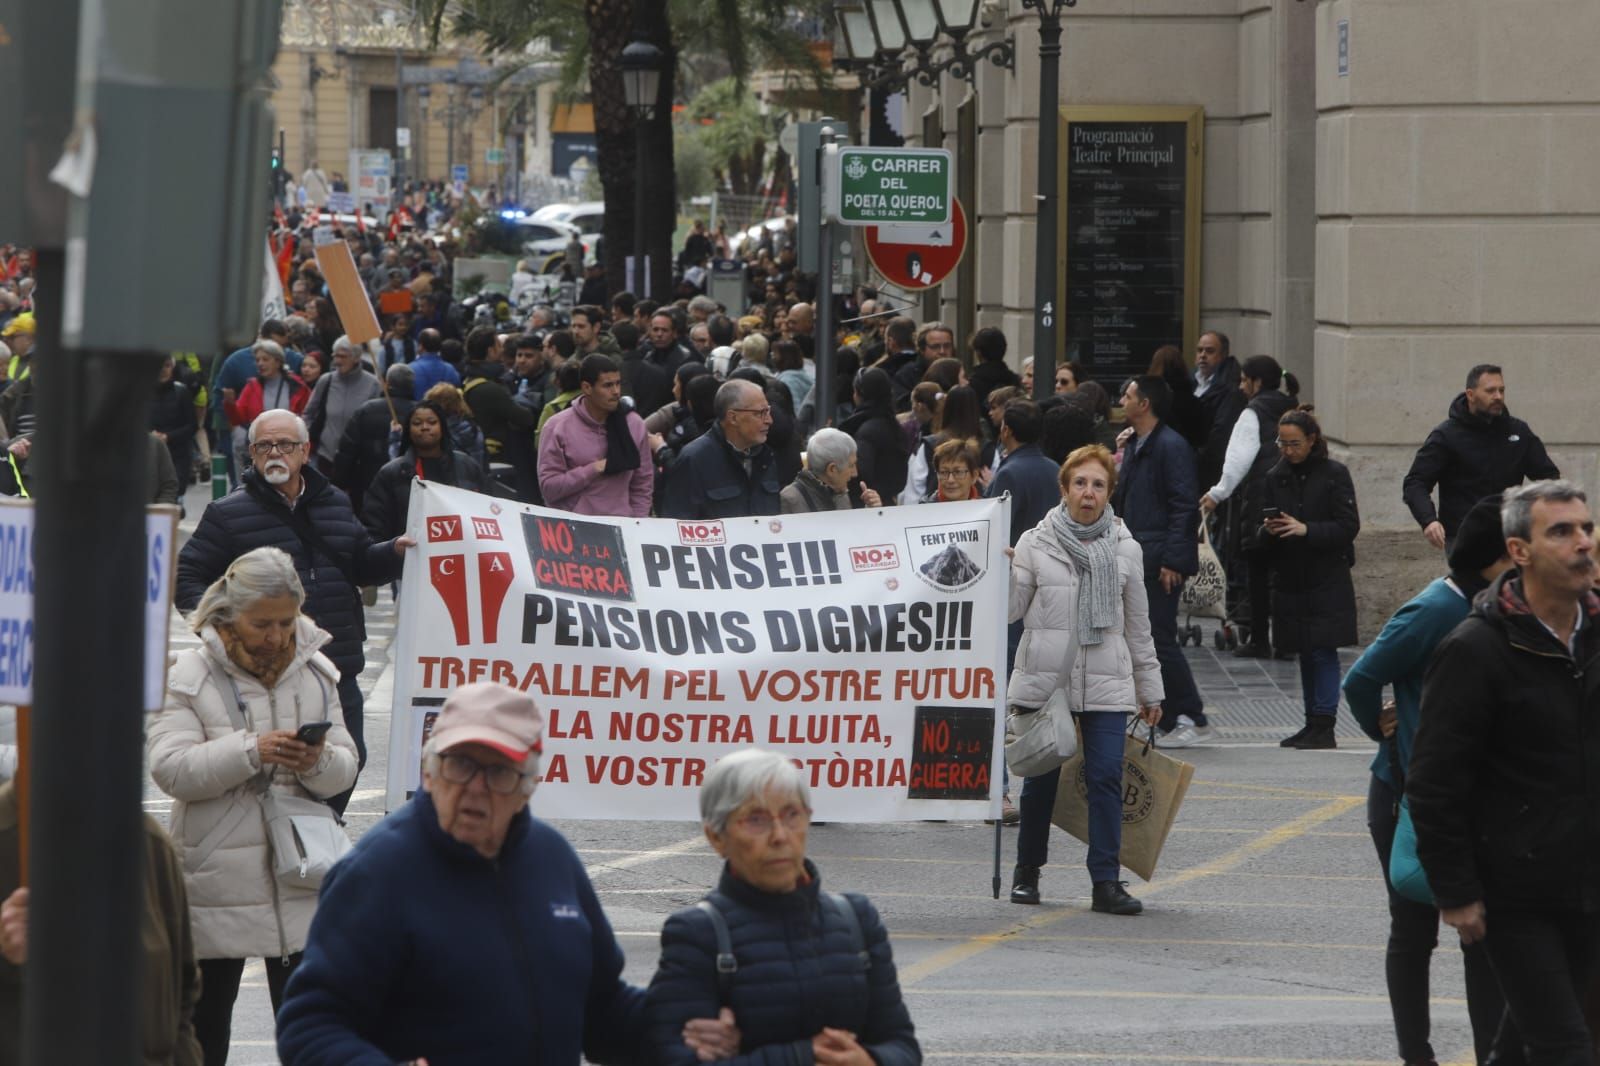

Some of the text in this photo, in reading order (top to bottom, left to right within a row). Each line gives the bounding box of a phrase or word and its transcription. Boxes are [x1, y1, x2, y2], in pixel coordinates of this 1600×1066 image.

[1074, 127, 1154, 148] Programació
[871, 158, 941, 173] CARRER
[1072, 144, 1174, 168] Teatre Principal
[880, 177, 908, 189] DEL
[844, 194, 944, 209] POETA QUEROL
[430, 519, 500, 538] SV HE
[536, 518, 573, 554] NO
[595, 544, 612, 560] LA
[921, 529, 979, 546] FENT PINYA
[439, 556, 504, 575] C A
[535, 558, 629, 594] GUERRA
[641, 540, 842, 590] PENSE!!!
[521, 593, 973, 656] PENSIONS DIGNES!!!
[418, 656, 995, 702] TREBALLEM PEL VOSTRE FUTUR
[548, 708, 892, 748] LA NOSTRA LLUITA,
[922, 719, 949, 755] NO
[968, 739, 981, 752] LA
[536, 754, 569, 783] A
[585, 755, 720, 787] VOSTR
[910, 762, 990, 790] GUERRA
[1124, 783, 1139, 806] B
